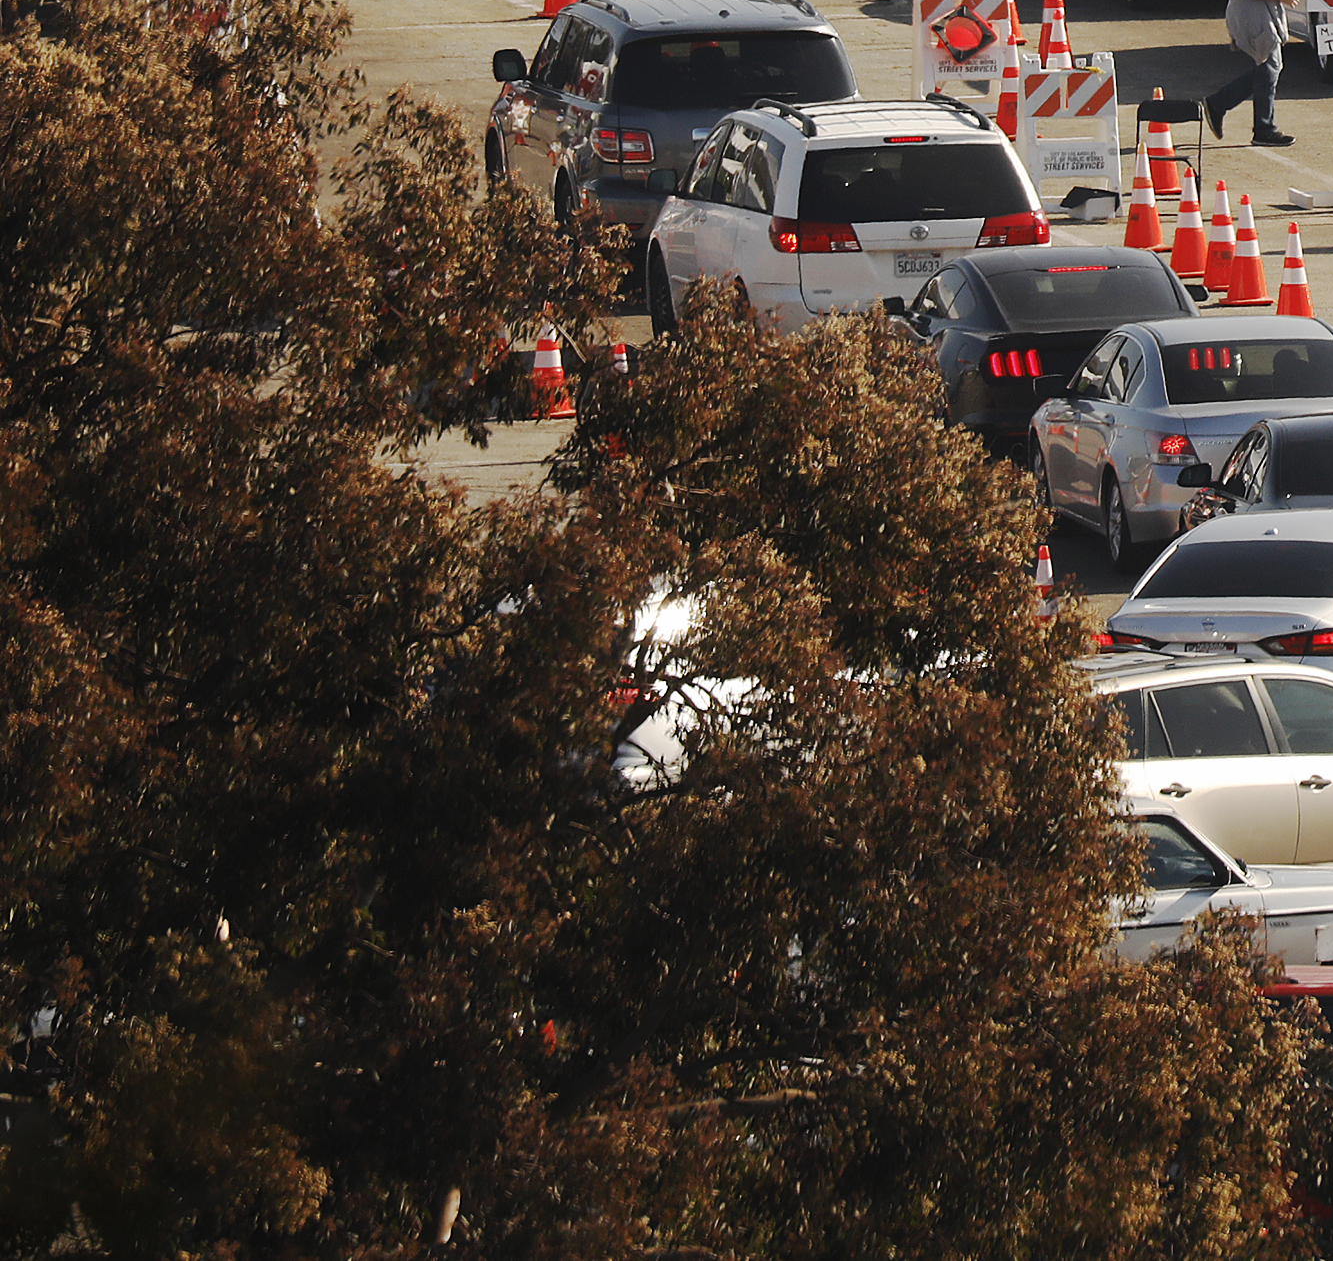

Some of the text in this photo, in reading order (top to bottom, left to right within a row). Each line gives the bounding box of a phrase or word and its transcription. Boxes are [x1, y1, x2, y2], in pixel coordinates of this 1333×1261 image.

[938, 65, 998, 73] STREET SERVICES
[1044, 161, 1105, 171] STREET SERVICES
[898, 260, 940, 273] 5CDJ633
